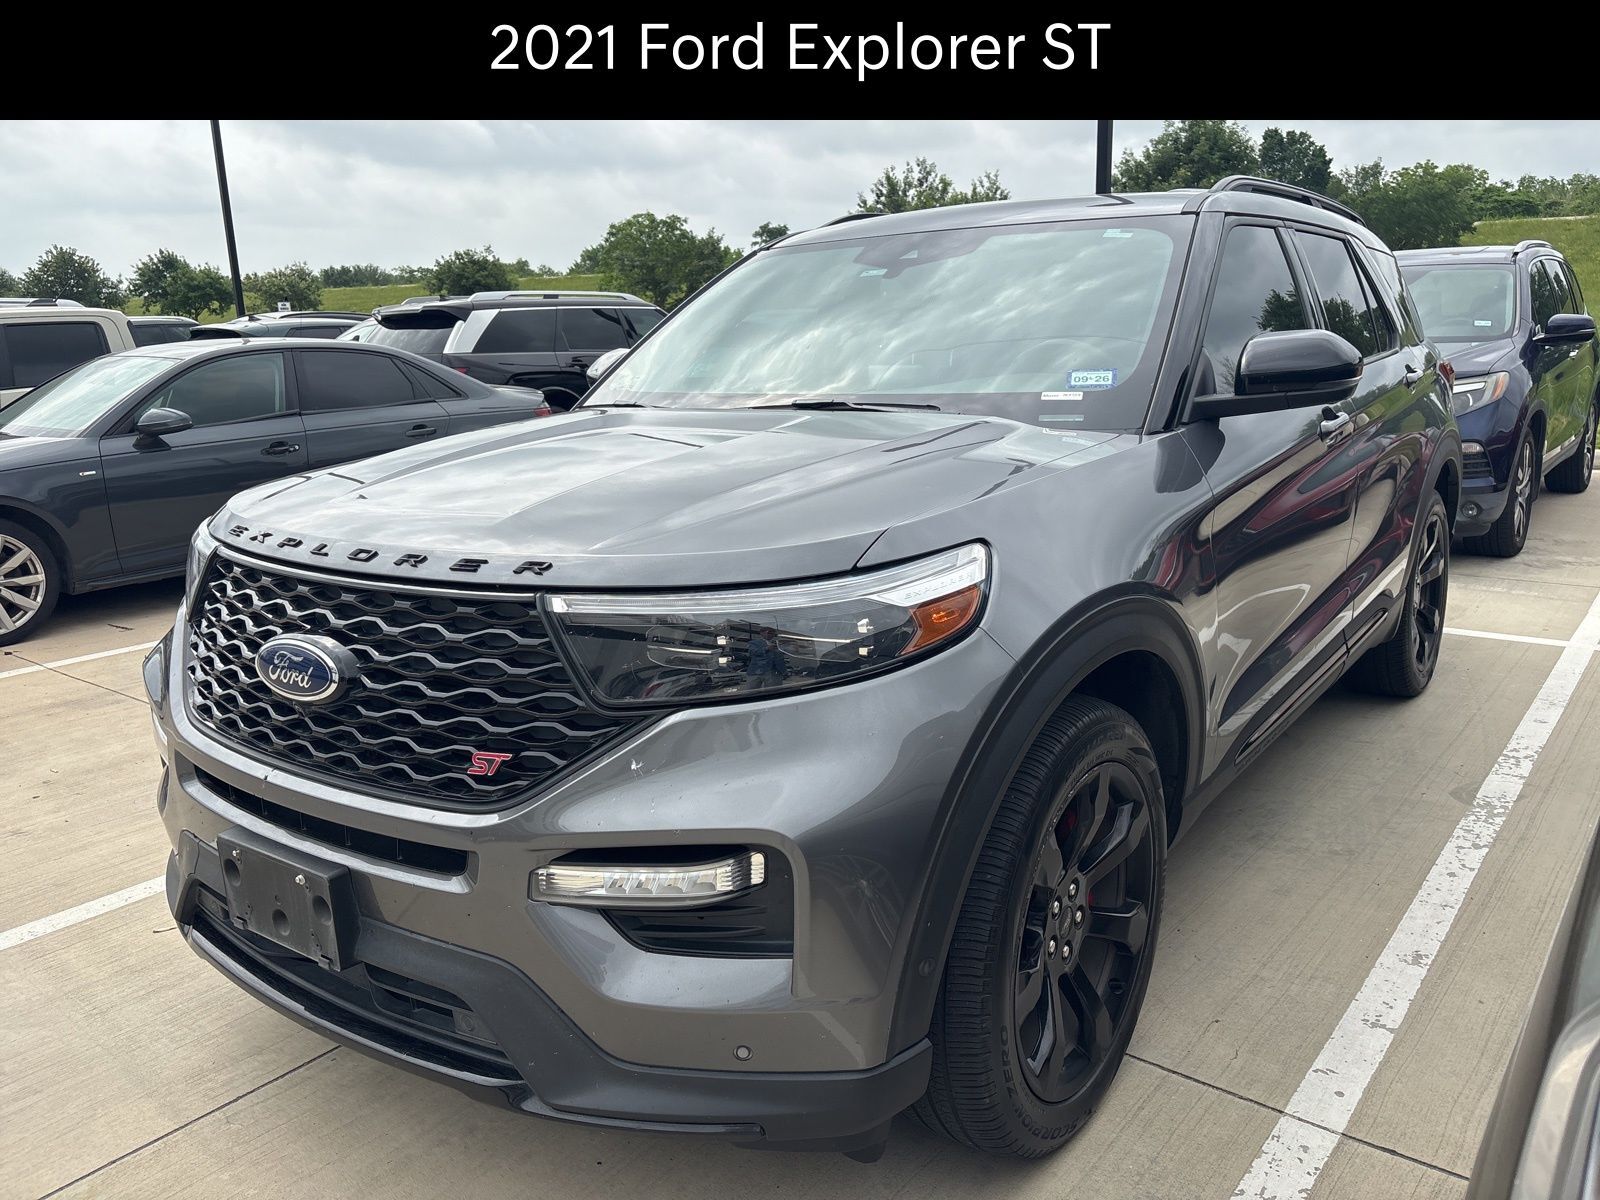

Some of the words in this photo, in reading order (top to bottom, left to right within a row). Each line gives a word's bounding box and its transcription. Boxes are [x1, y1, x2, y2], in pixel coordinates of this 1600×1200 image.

[1073, 375, 1089, 383] 09
[1094, 374, 1110, 383] 26
[229, 524, 554, 577] EXPLORER
[268, 650, 313, 689] Ford
[467, 750, 513, 777] ST
[1000, 1024, 1017, 1099] ZERO
